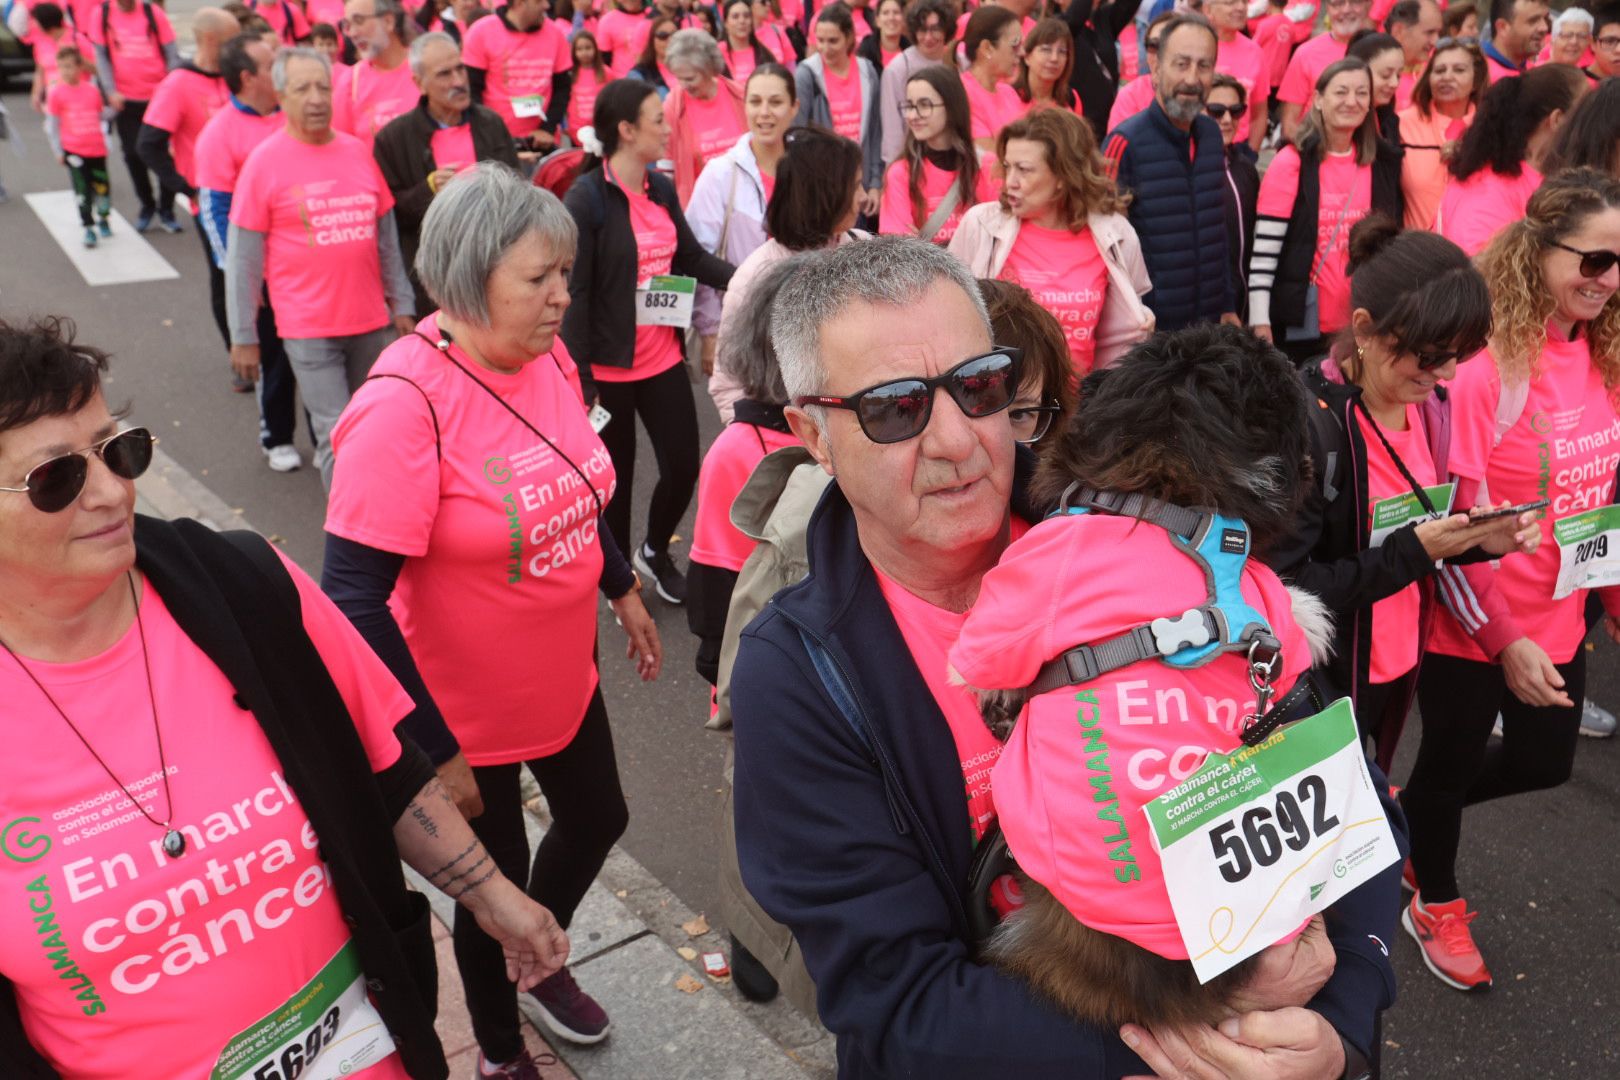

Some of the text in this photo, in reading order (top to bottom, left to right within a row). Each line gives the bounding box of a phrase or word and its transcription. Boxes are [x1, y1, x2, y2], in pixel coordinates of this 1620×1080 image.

[306, 198, 327, 212] En
[316, 223, 375, 245] cánce
[640, 257, 671, 275] ontr
[645, 292, 678, 308] 8832
[1555, 438, 1575, 460] En
[519, 482, 555, 512] En
[556, 446, 613, 496] march
[608, 479, 617, 501] e
[1536, 441, 1550, 520] SAMANCA
[1553, 479, 1612, 514] cánc
[503, 493, 524, 584] SALAMANCA
[529, 517, 598, 577] cánc
[1574, 534, 1608, 566] 2019
[1116, 679, 1189, 726] En
[961, 743, 1005, 771] sociació
[966, 766, 994, 785] ontr
[52, 789, 120, 820] asociación
[1074, 688, 1142, 884] SALAMANCA
[1159, 763, 1231, 804] Salamanca
[1166, 793, 1206, 820] contra
[1207, 782, 1219, 796] el
[1221, 763, 1258, 789] cáner
[1178, 810, 1204, 827] MARCHA
[1204, 793, 1230, 811] CONTRA
[1239, 777, 1262, 793] CÁCER
[58, 812, 99, 832] contra
[101, 804, 114, 816] el
[62, 771, 296, 903] En march
[63, 834, 80, 845] en
[1209, 775, 1339, 883] 5692
[81, 820, 321, 953] contra e
[25, 874, 107, 1017] SALAMANCA
[110, 860, 334, 994] cánce
[219, 1020, 277, 1063] Salamanca
[219, 1012, 302, 1073] contra el cáncer
[253, 1005, 340, 1080] 5693
